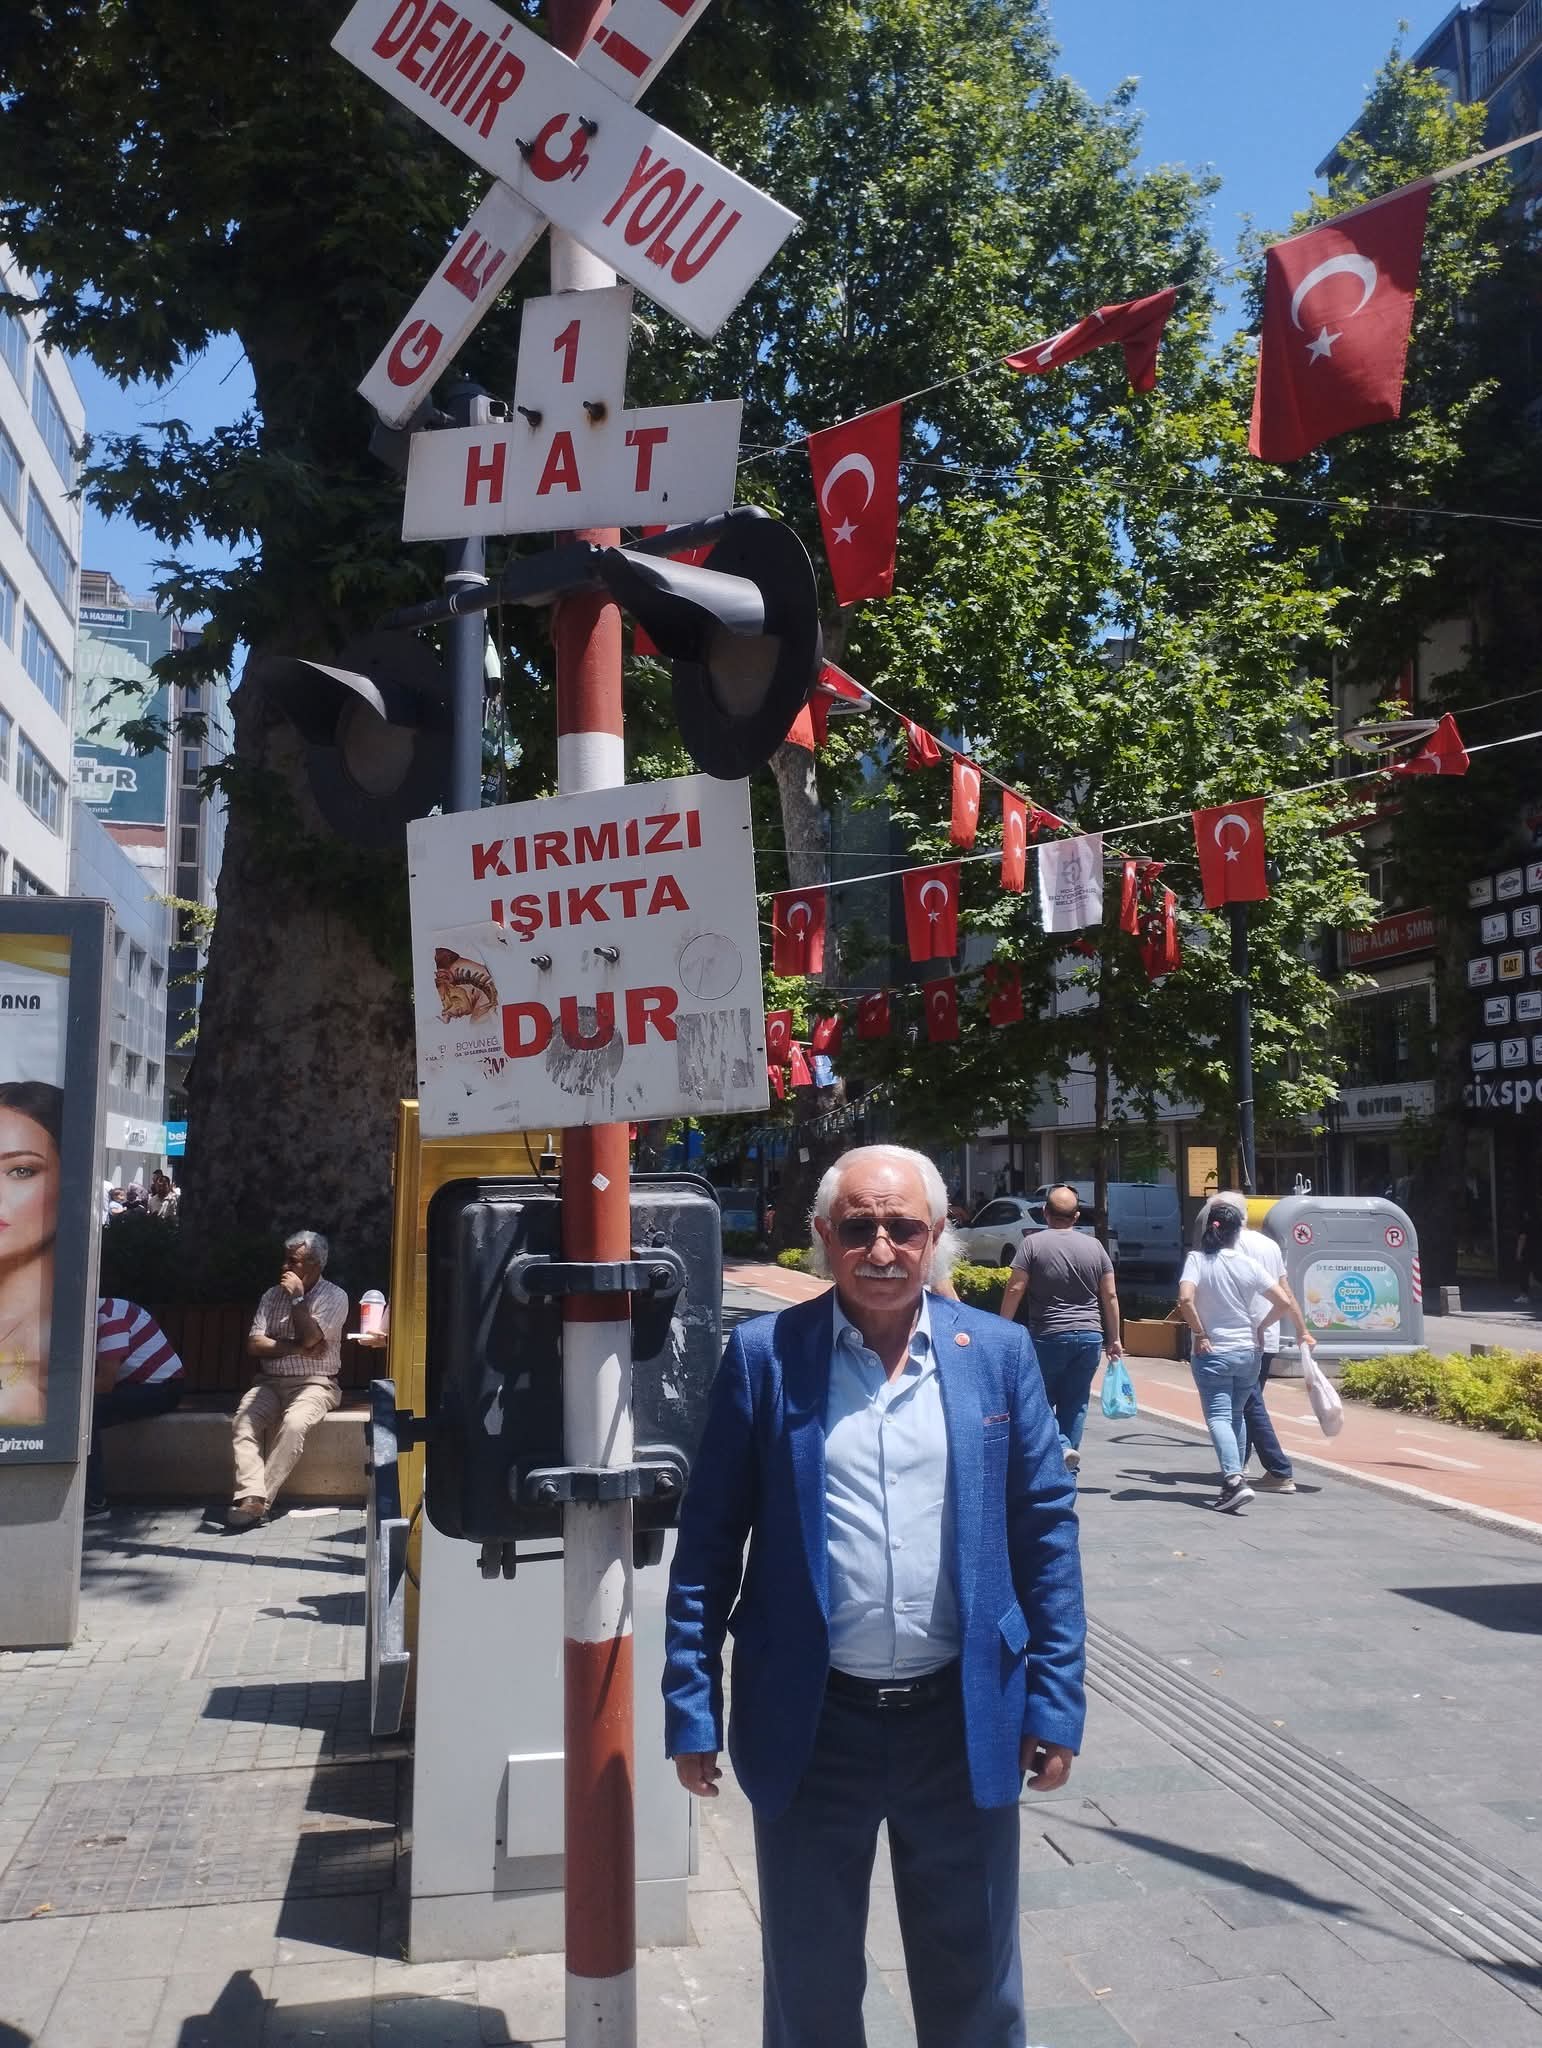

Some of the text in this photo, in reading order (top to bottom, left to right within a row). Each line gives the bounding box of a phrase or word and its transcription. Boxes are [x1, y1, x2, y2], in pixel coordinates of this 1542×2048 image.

[602, 145, 744, 285] YOLU
[553, 319, 582, 385] 1
[463, 426, 669, 508] HAT
[471, 810, 703, 881] KIRMIZI
[490, 875, 690, 943] IŞIKTA
[0, 993, 41, 1010] ANA
[501, 985, 680, 1060] DUR
